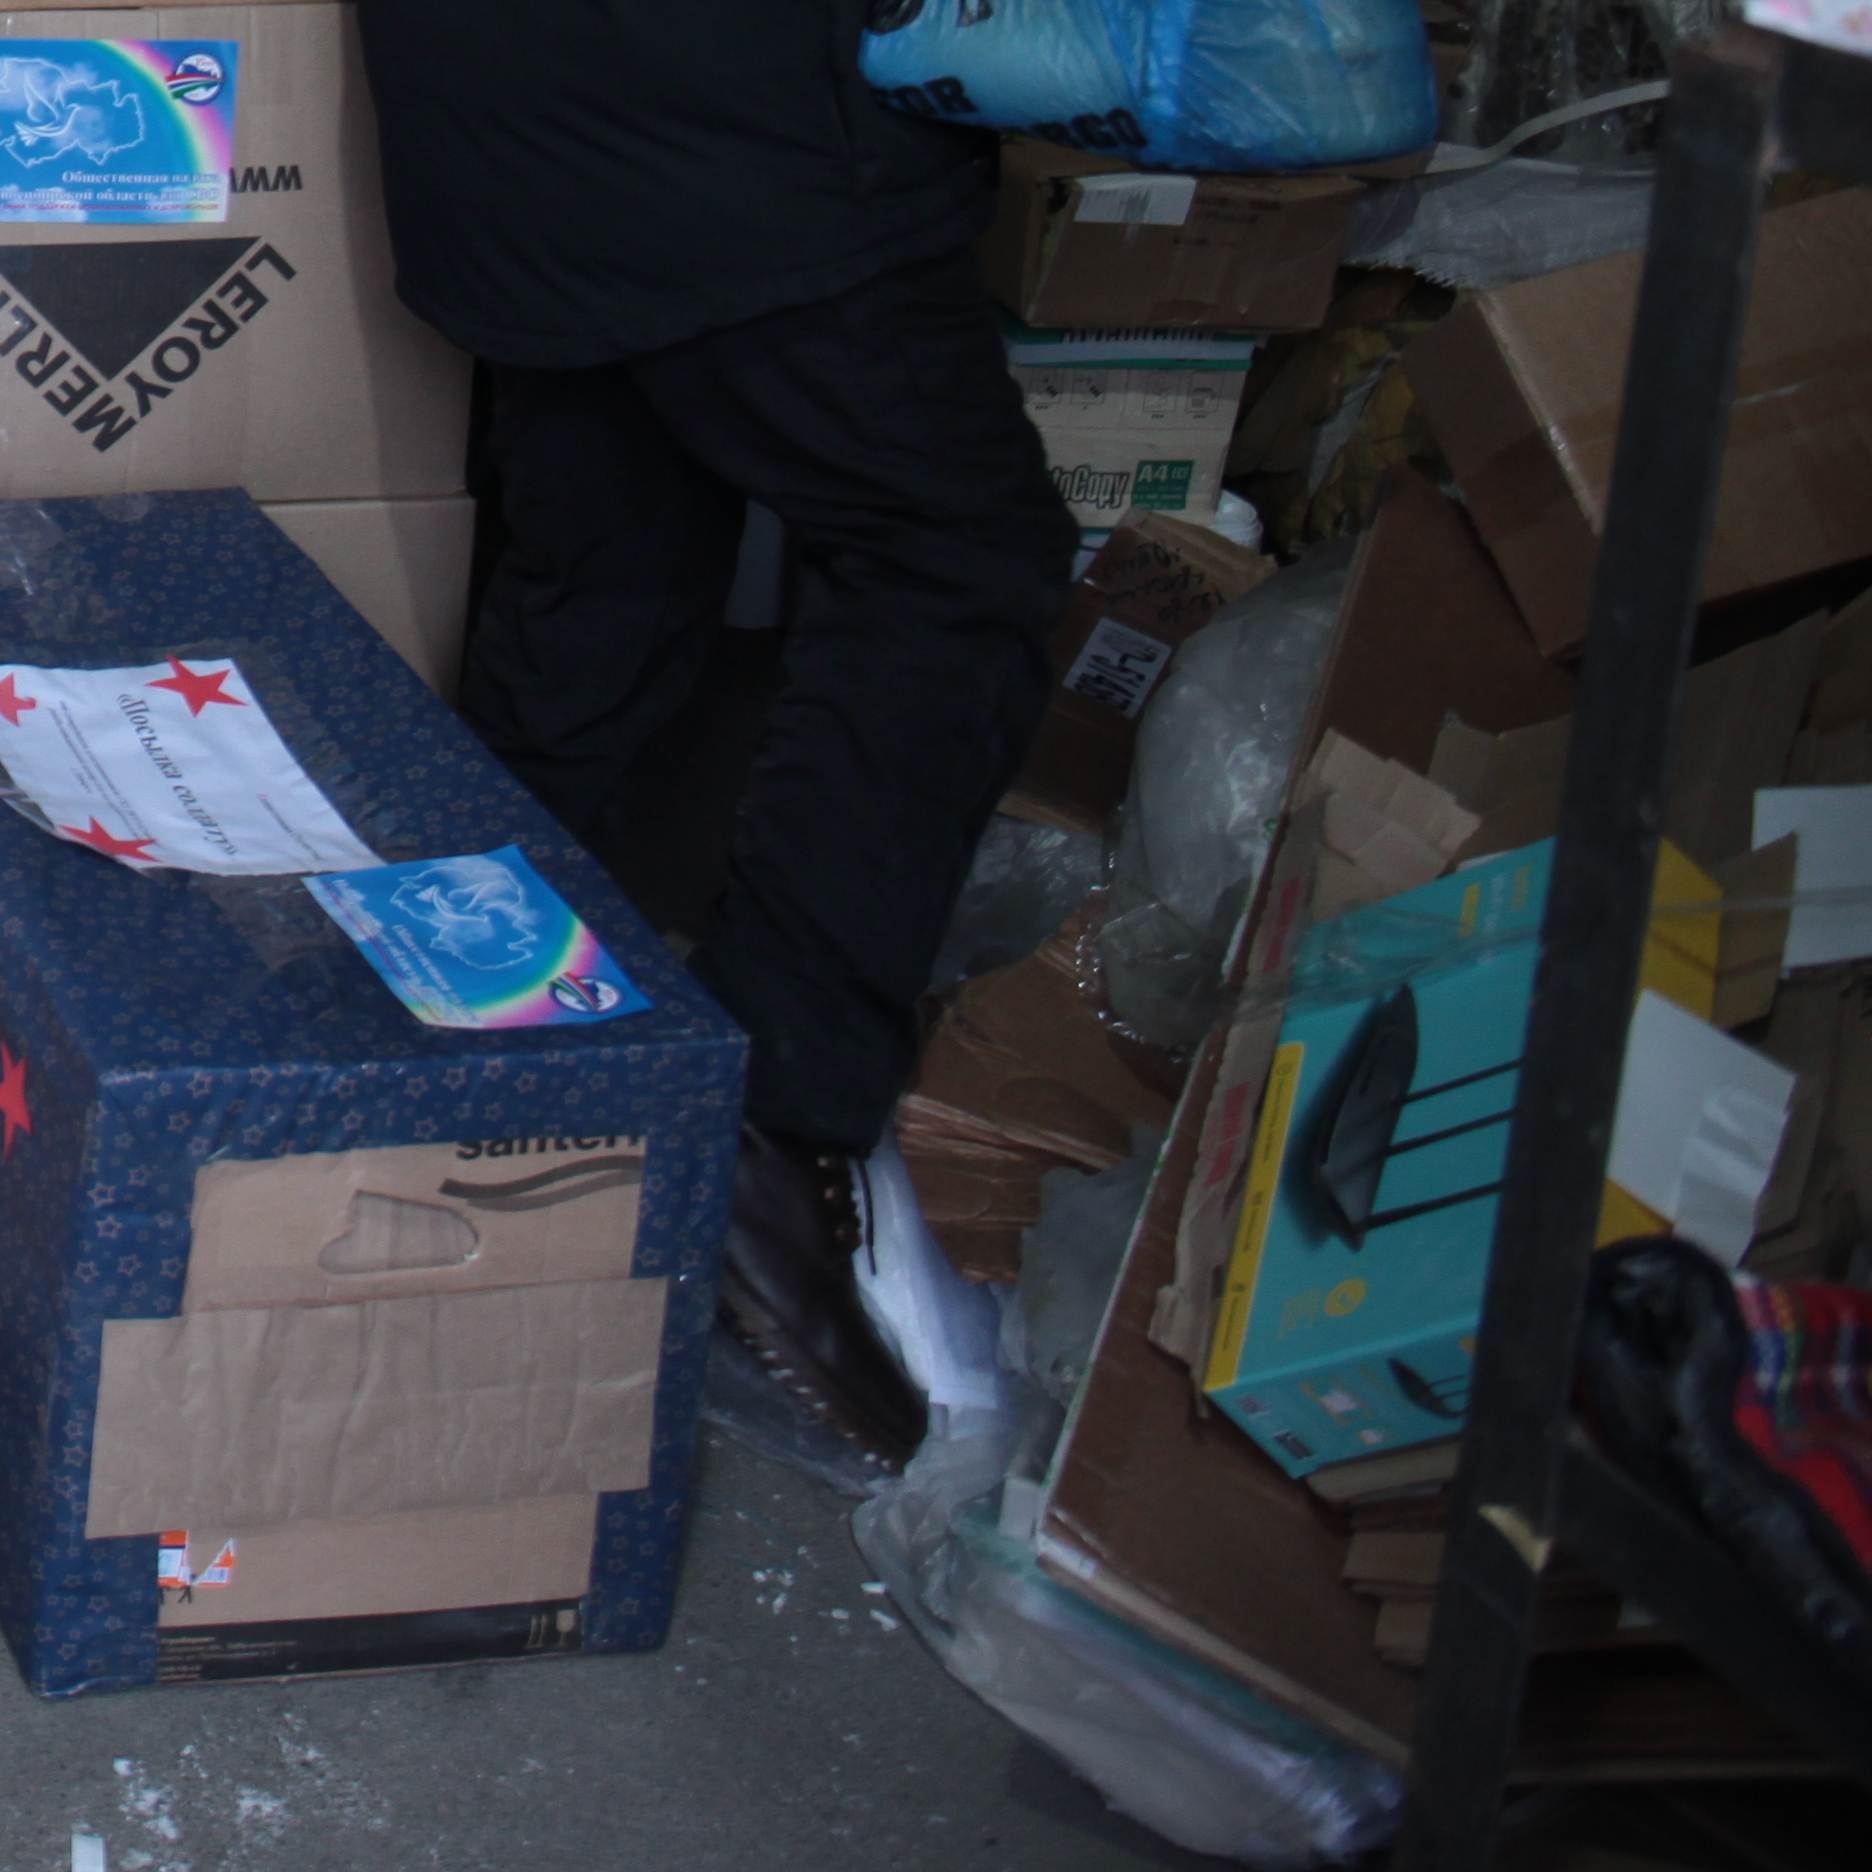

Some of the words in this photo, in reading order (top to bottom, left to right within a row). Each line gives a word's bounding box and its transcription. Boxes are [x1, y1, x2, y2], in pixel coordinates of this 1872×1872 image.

[62, 170, 169, 184] Общественная
[128, 238, 300, 419] LEROY
[1137, 466, 1169, 483] A4
[116, 691, 186, 785] «Посылка
[170, 777, 243, 859] солдату»
